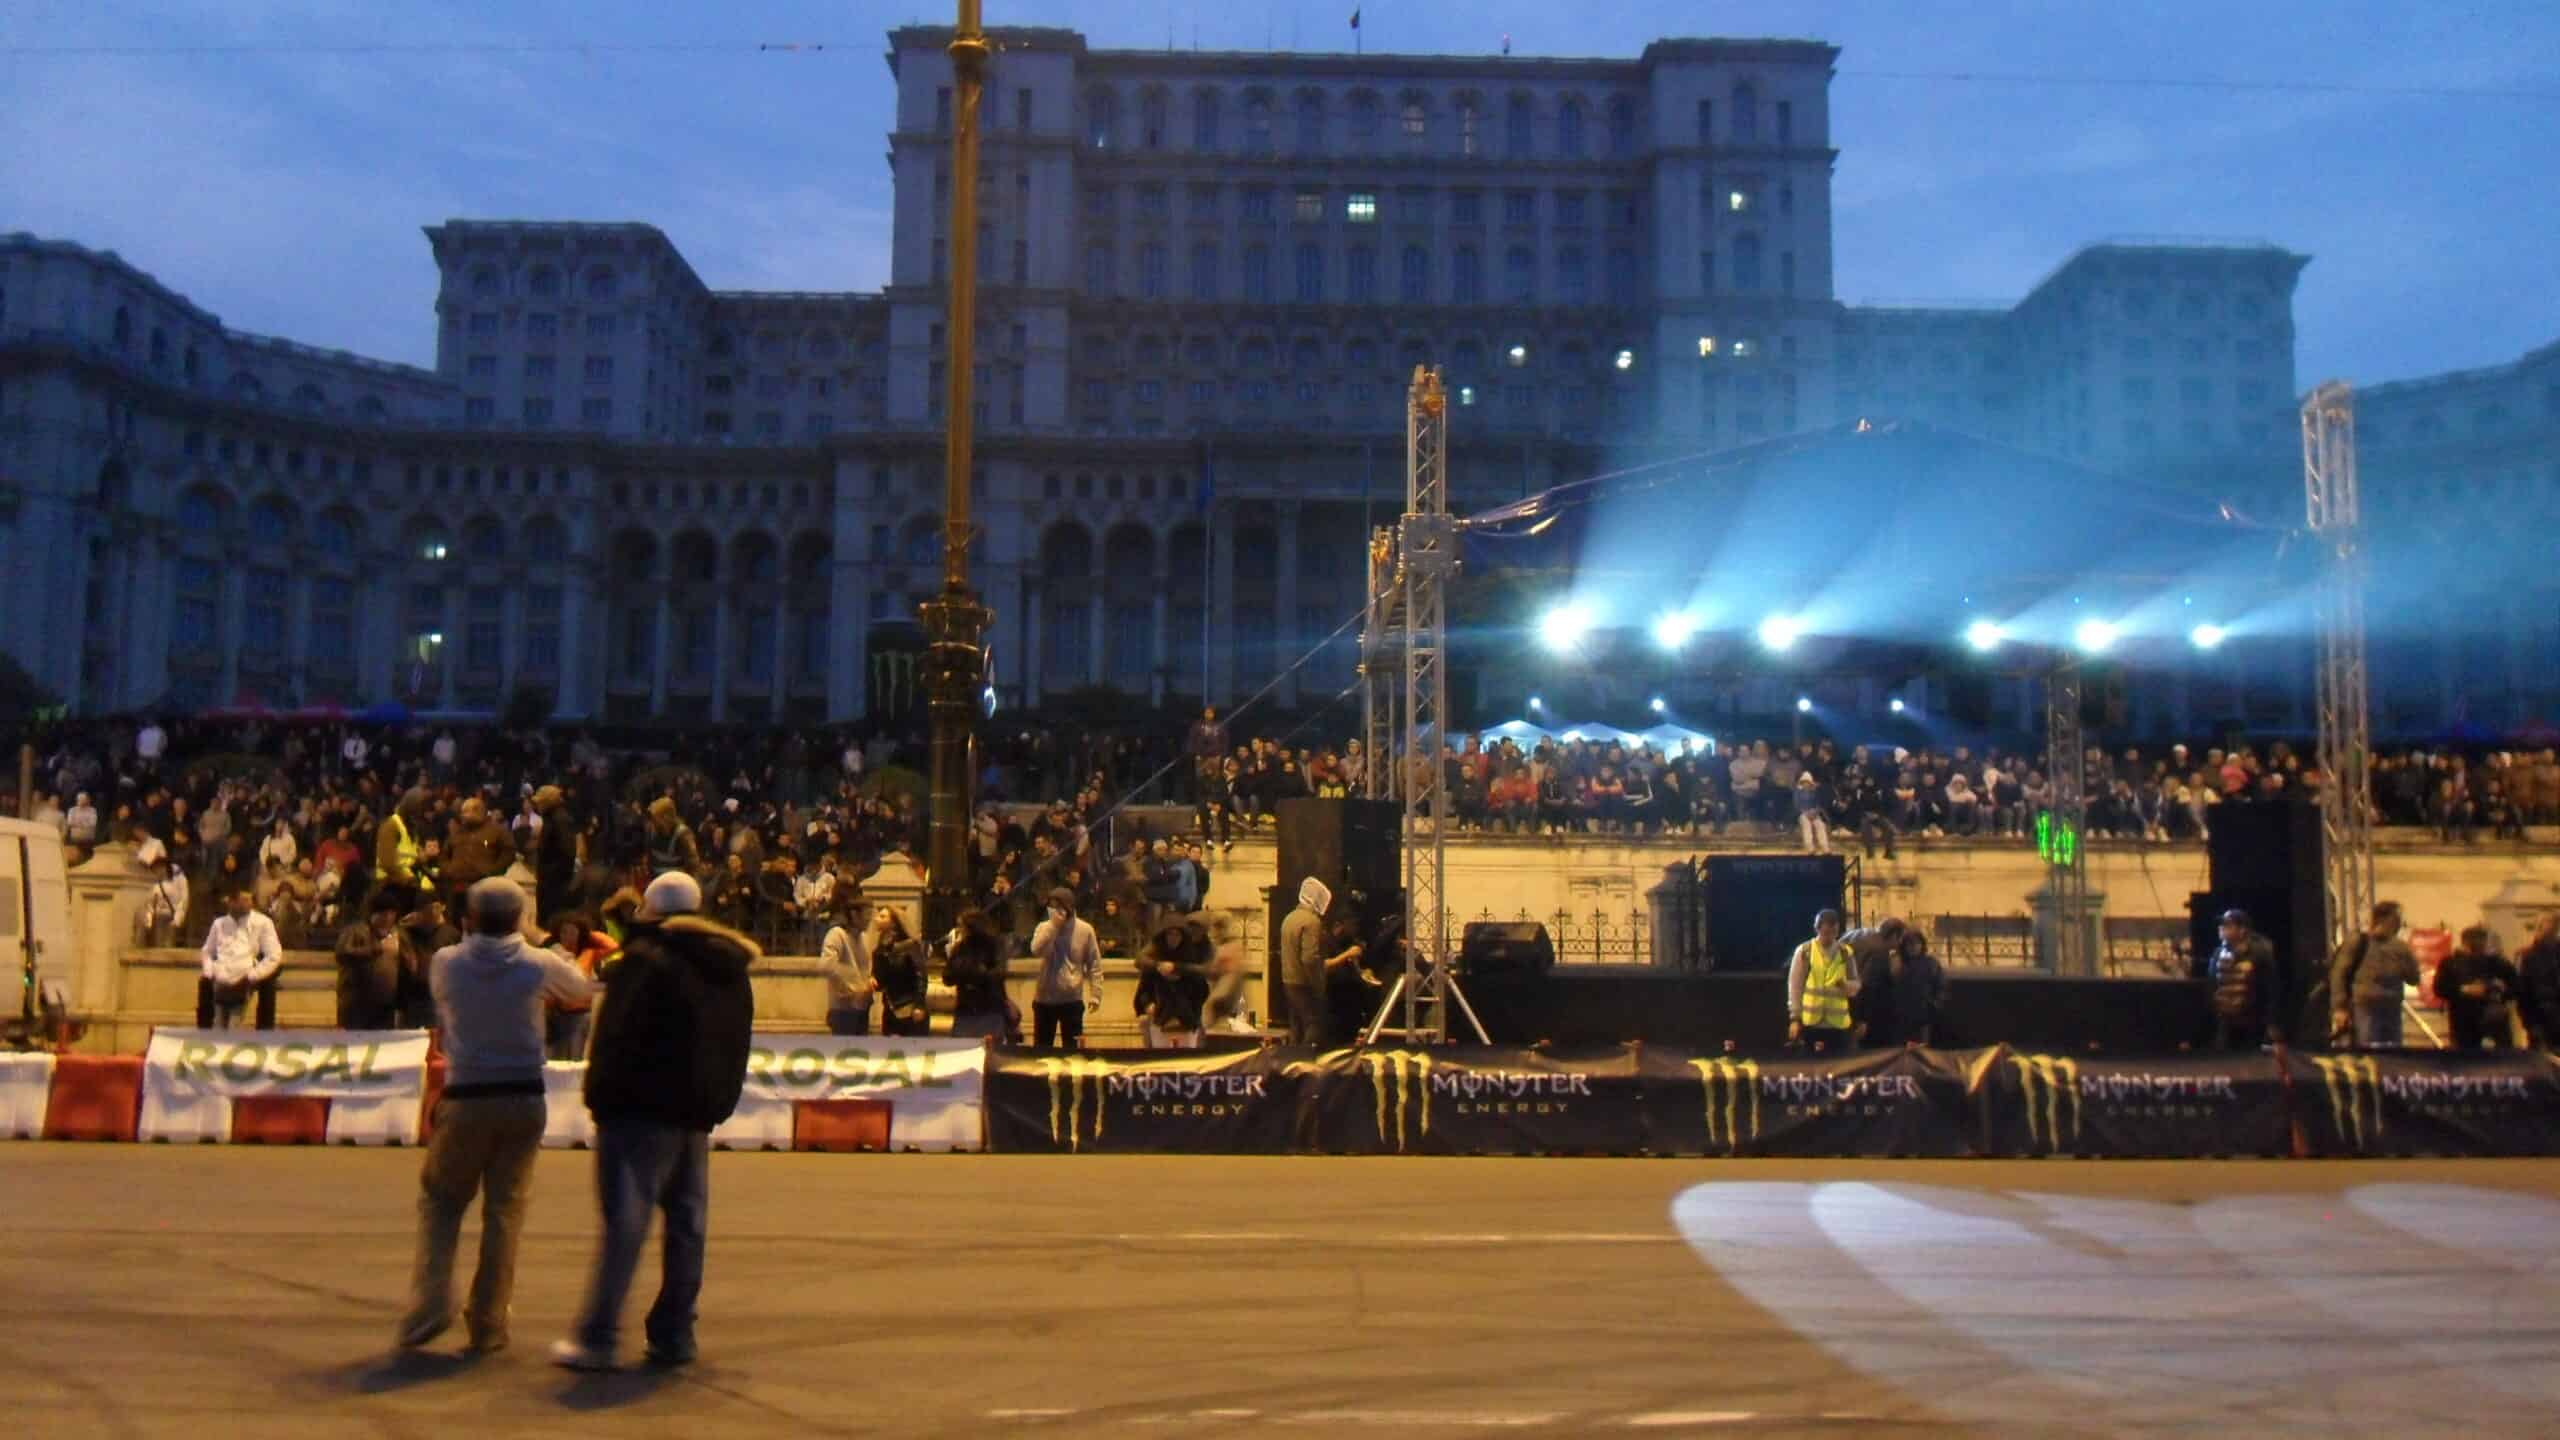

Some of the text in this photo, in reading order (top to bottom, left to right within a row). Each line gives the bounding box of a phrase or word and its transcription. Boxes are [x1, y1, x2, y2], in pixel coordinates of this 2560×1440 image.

[174, 1041, 393, 1082] ROSAL
[749, 1047, 953, 1087] ROSAL
[1107, 1071, 1267, 1100] MONSTER
[1432, 1070, 1592, 1099] MONSTER
[1762, 1072, 1919, 1101] MONSTER
[2081, 1073, 2237, 1100] MONSTER
[2382, 1073, 2530, 1100] MONSTER
[1131, 1103, 1244, 1116] ENERGY
[1457, 1103, 1569, 1114] ENERGY
